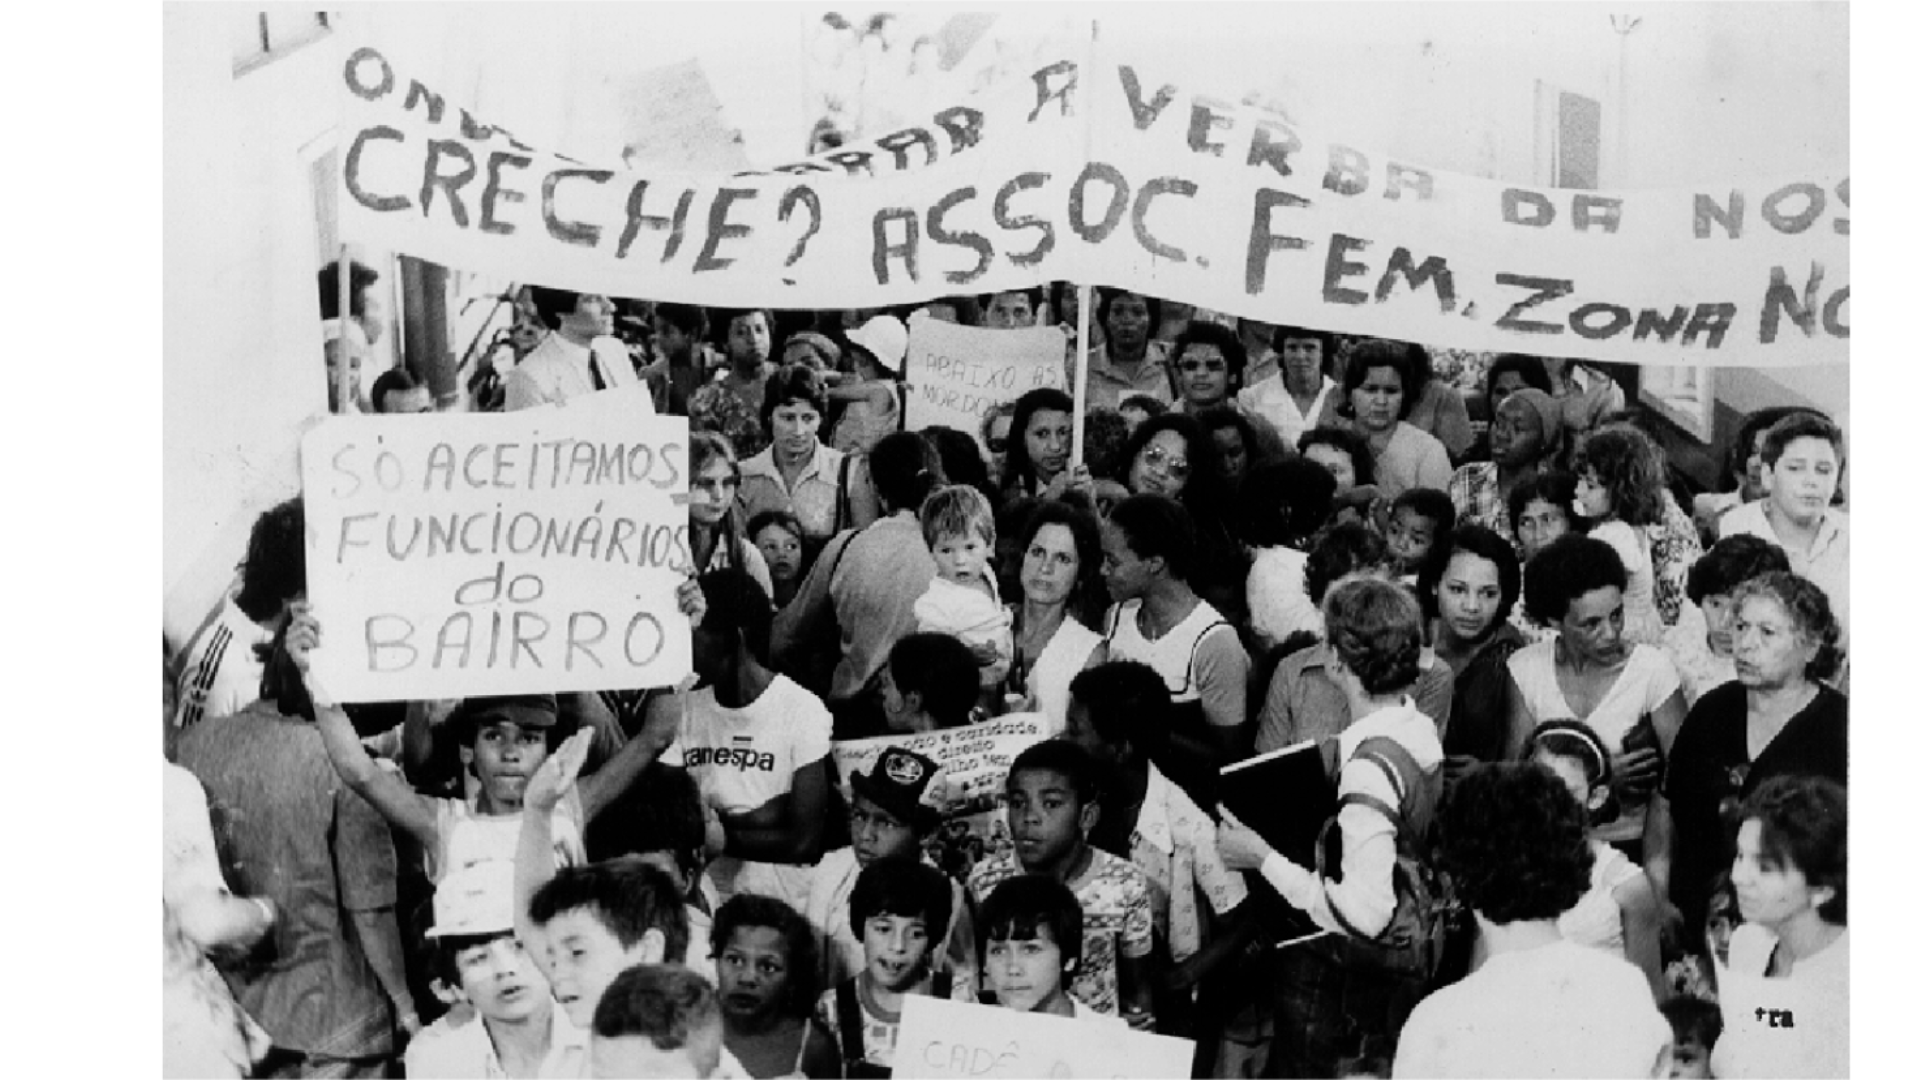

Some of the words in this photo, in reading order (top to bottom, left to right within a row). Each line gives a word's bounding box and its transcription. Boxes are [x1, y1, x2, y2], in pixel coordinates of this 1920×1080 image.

[1028, 60, 1078, 122] A
[1117, 65, 1434, 200] VERBA
[1501, 187, 1624, 234] DA
[344, 125, 822, 285] CRECHE?
[872, 161, 1209, 285] ASSOC.
[1244, 187, 1479, 321] FEM.
[1494, 272, 1738, 350] ZONA
[926, 353, 1017, 390] ABAIXO
[1032, 365, 1058, 388] AS
[424, 430, 683, 491] ACEITAMOS
[336, 500, 690, 576] FUNCIONÁRIOS
[454, 561, 543, 605] do
[364, 602, 666, 673] BAIRRO
